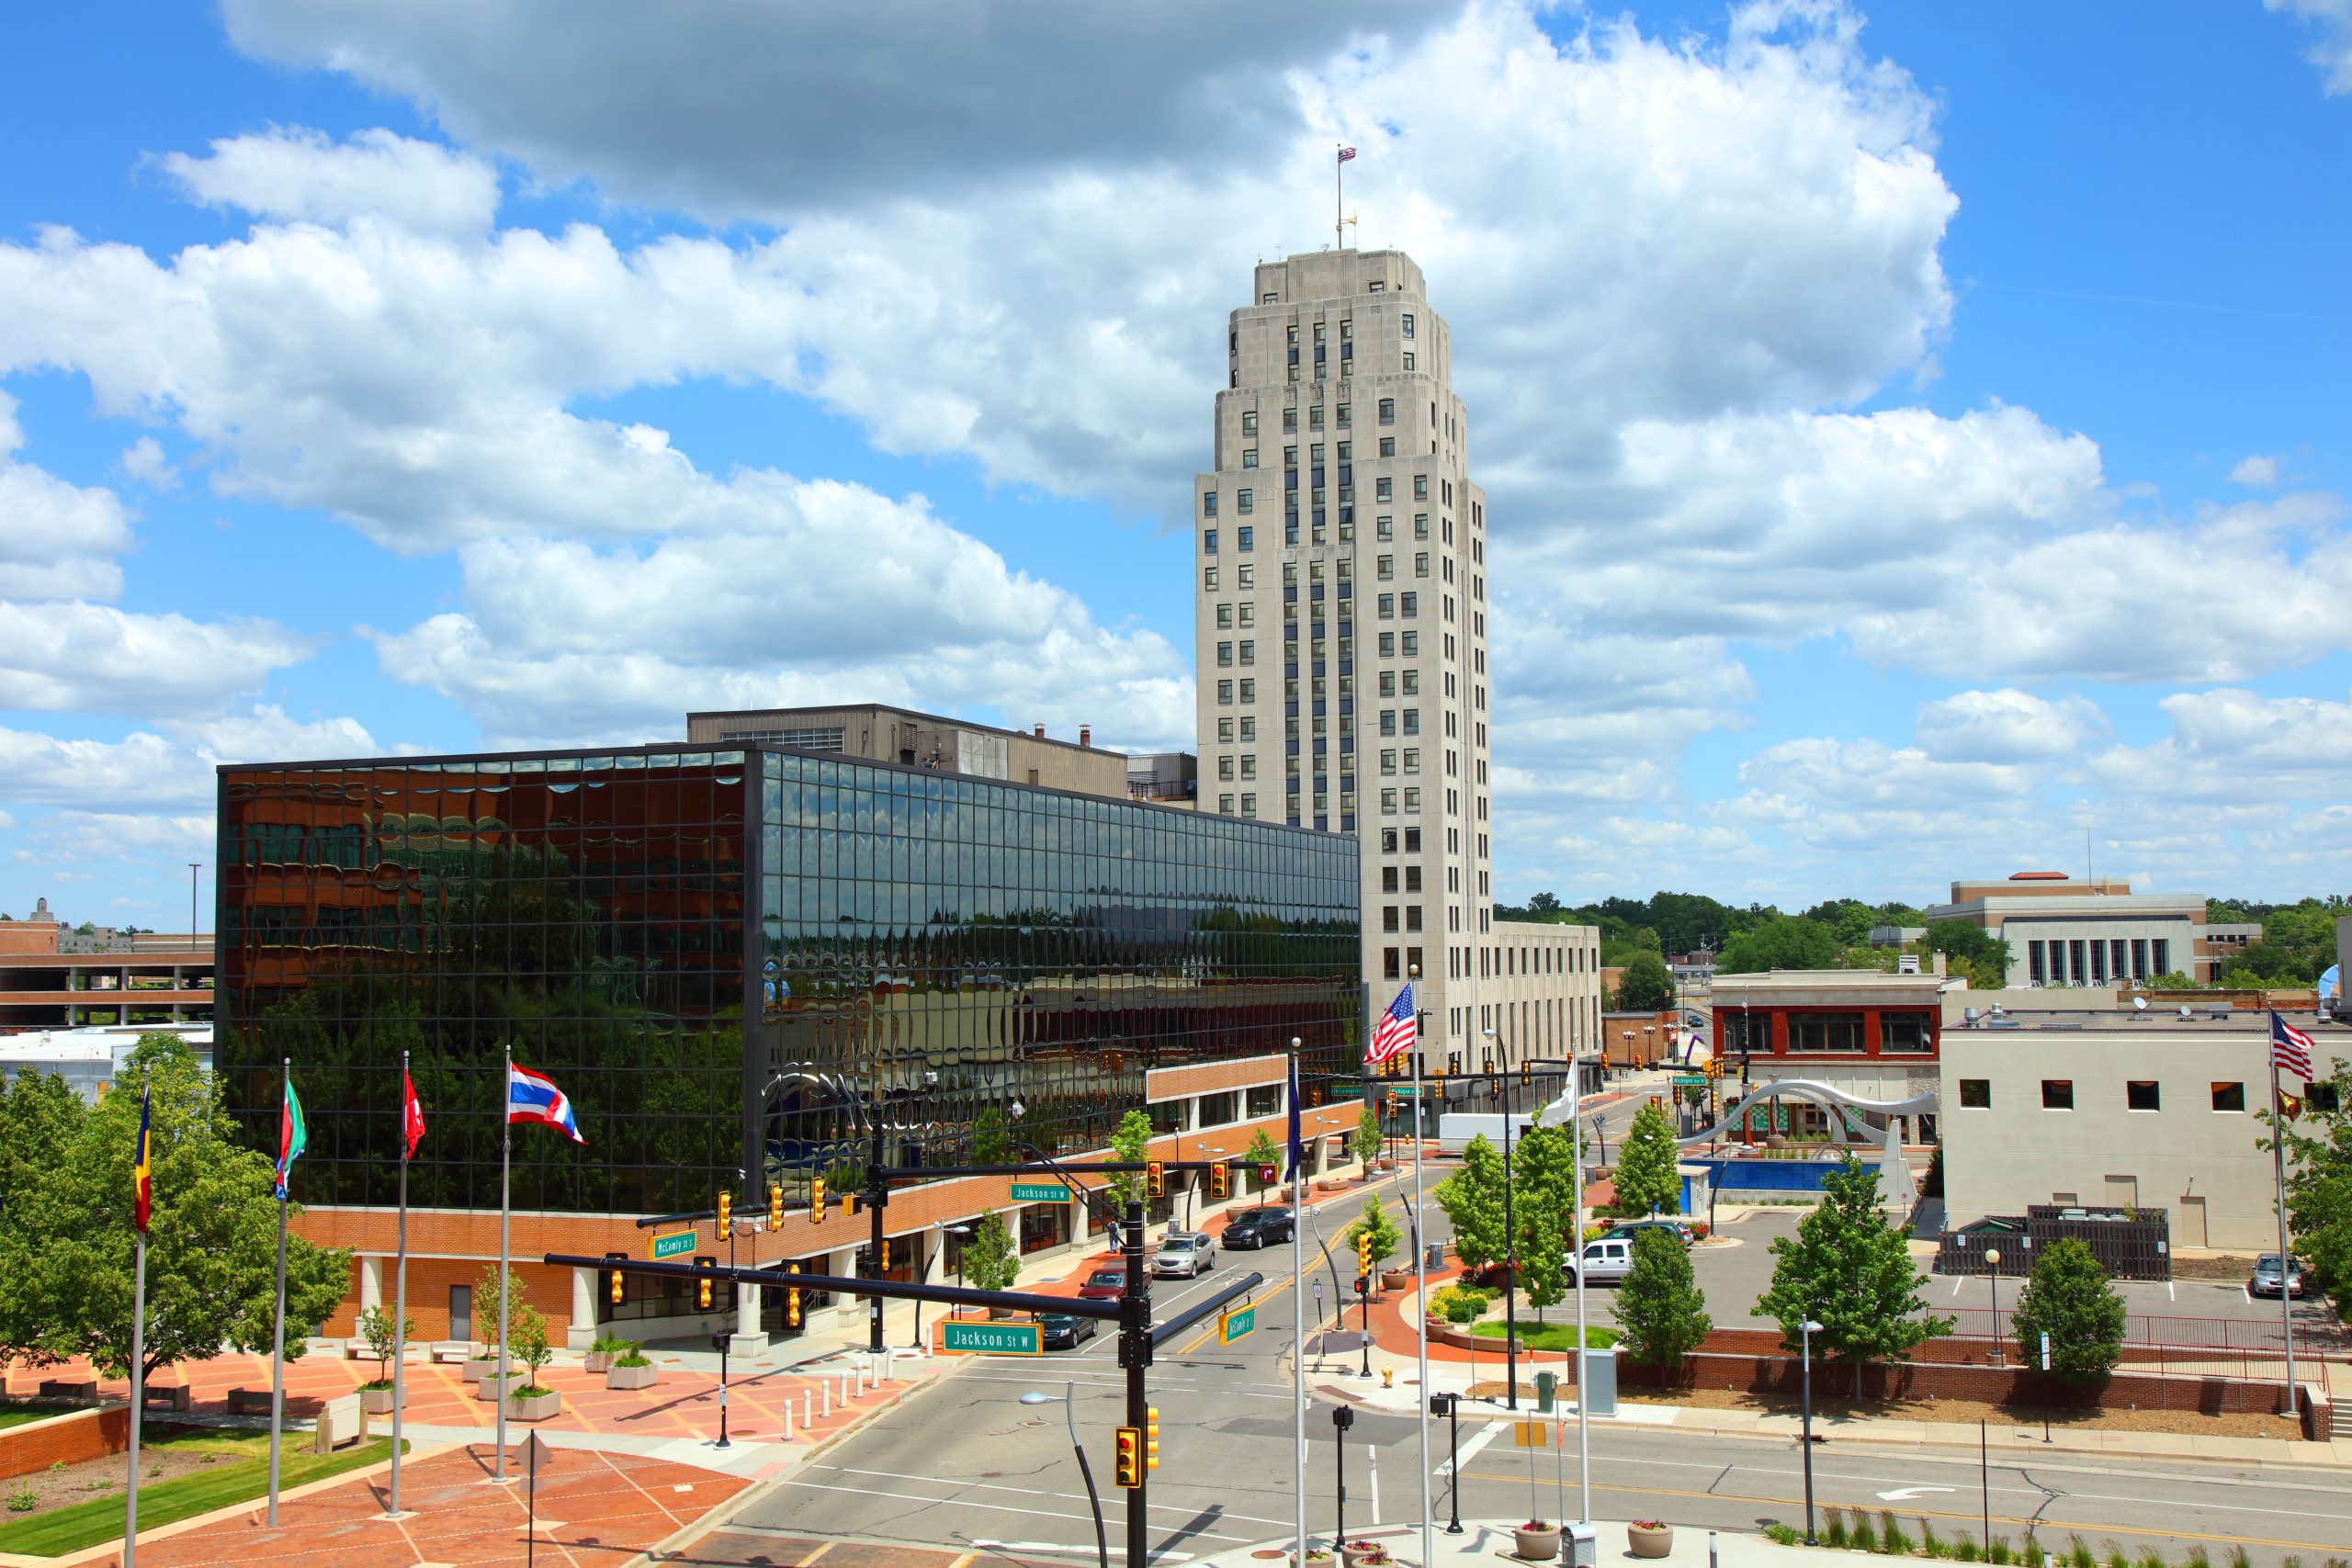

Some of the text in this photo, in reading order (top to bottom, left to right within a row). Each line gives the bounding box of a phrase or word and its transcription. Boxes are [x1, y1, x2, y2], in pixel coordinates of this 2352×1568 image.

[1016, 1187, 1065, 1199] Jackson St W
[658, 1238, 693, 1254] McCamly St S
[954, 1330, 1028, 1348] Jackson St W
